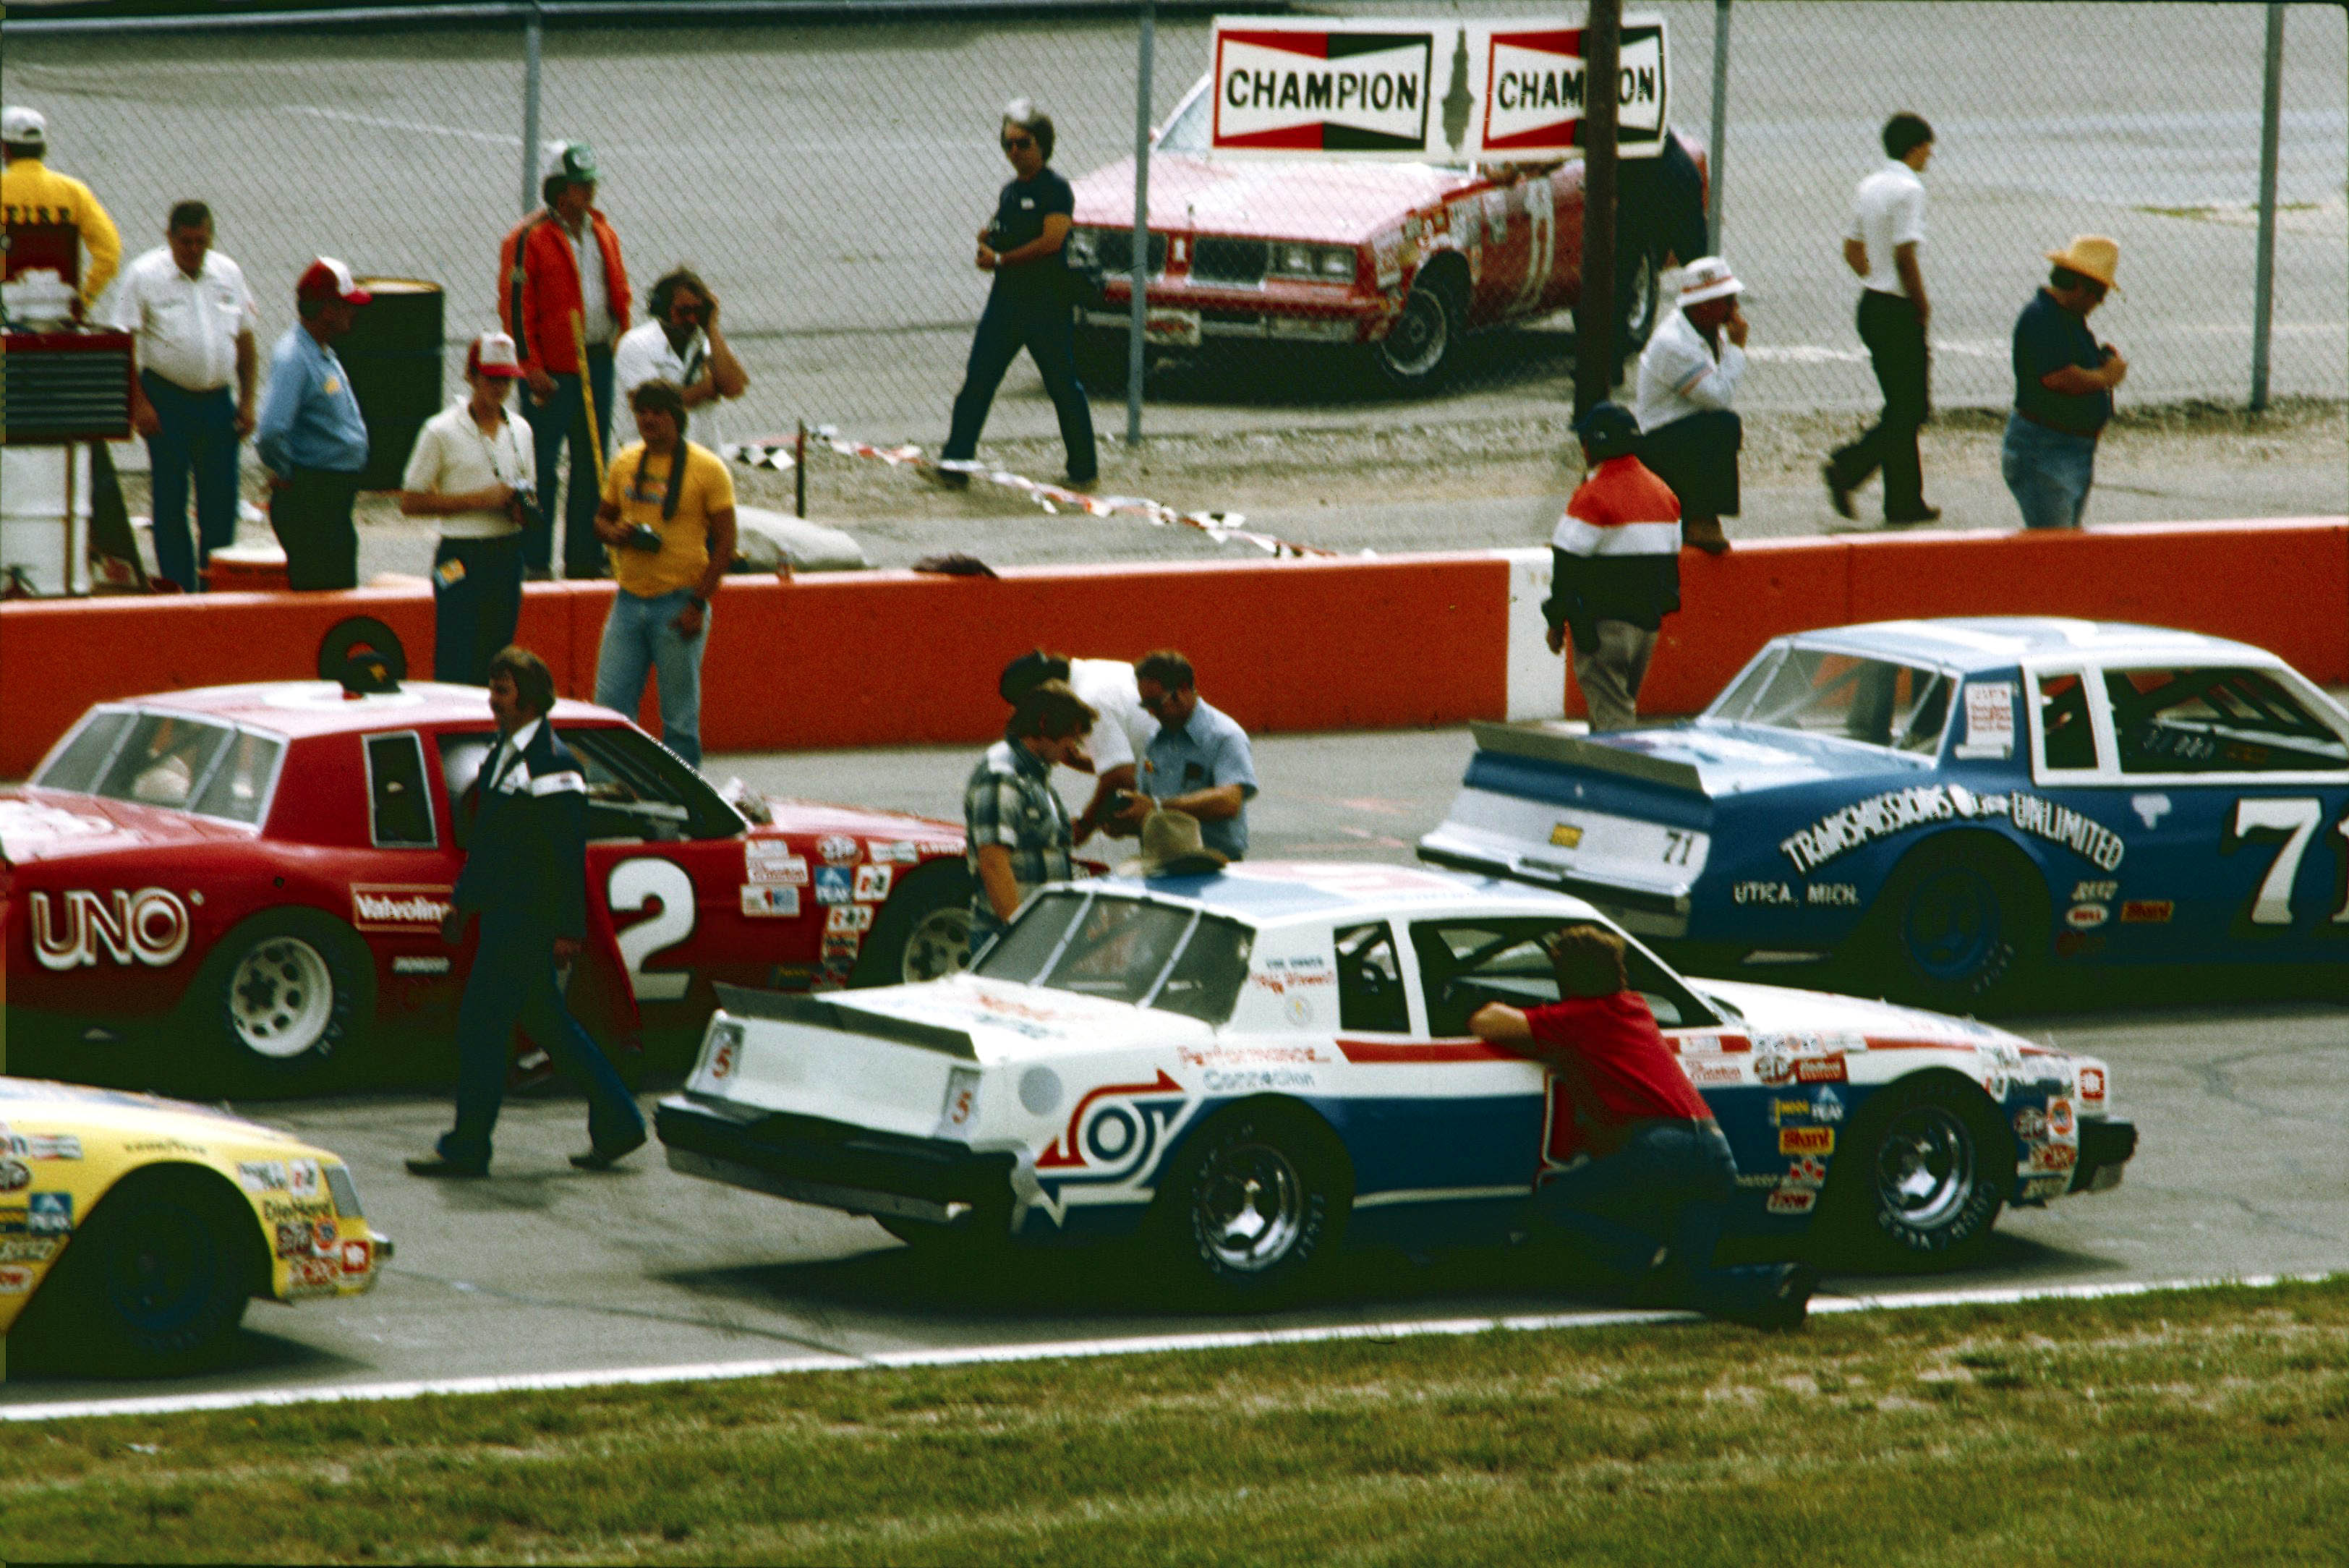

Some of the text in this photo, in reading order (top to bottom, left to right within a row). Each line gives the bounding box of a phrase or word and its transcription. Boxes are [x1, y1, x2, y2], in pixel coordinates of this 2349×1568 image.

[1228, 69, 1418, 110] CHAMPION
[1498, 68, 1655, 111] CHAMON
[1664, 832, 1694, 866] 71
[1779, 783, 2125, 873] TRANSMISSIONS UNLIMITED
[30, 886, 190, 971] UNO
[608, 856, 696, 1001] 2
